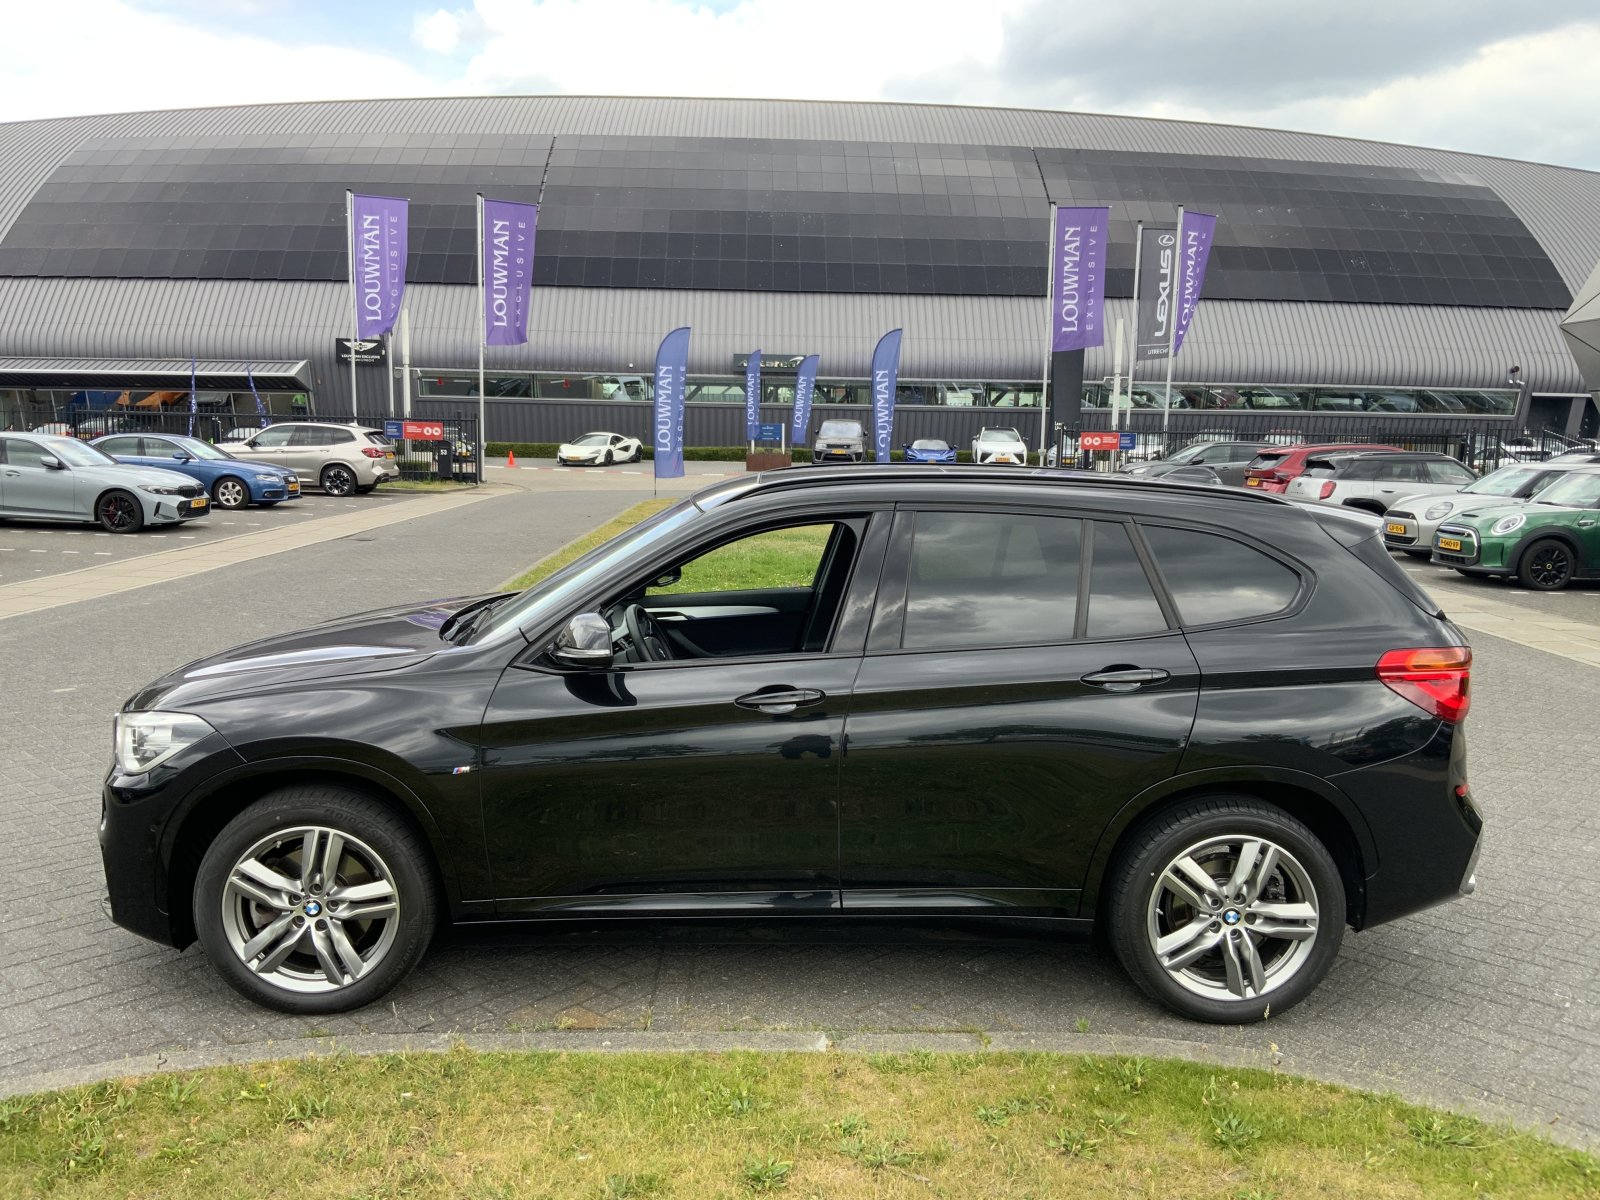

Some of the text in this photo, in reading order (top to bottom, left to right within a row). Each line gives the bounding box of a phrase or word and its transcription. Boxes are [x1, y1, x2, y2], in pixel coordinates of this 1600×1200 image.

[363, 214, 382, 321] LOUWMAN
[493, 219, 510, 327] LOUWMAN
[1062, 226, 1081, 334] LOUWMAN
[1086, 225, 1098, 331] EXCLUSIVE
[1154, 248, 1171, 337] LEXUS
[657, 365, 673, 452] LOUWMAN
[793, 376, 807, 428] LOUWMAN
